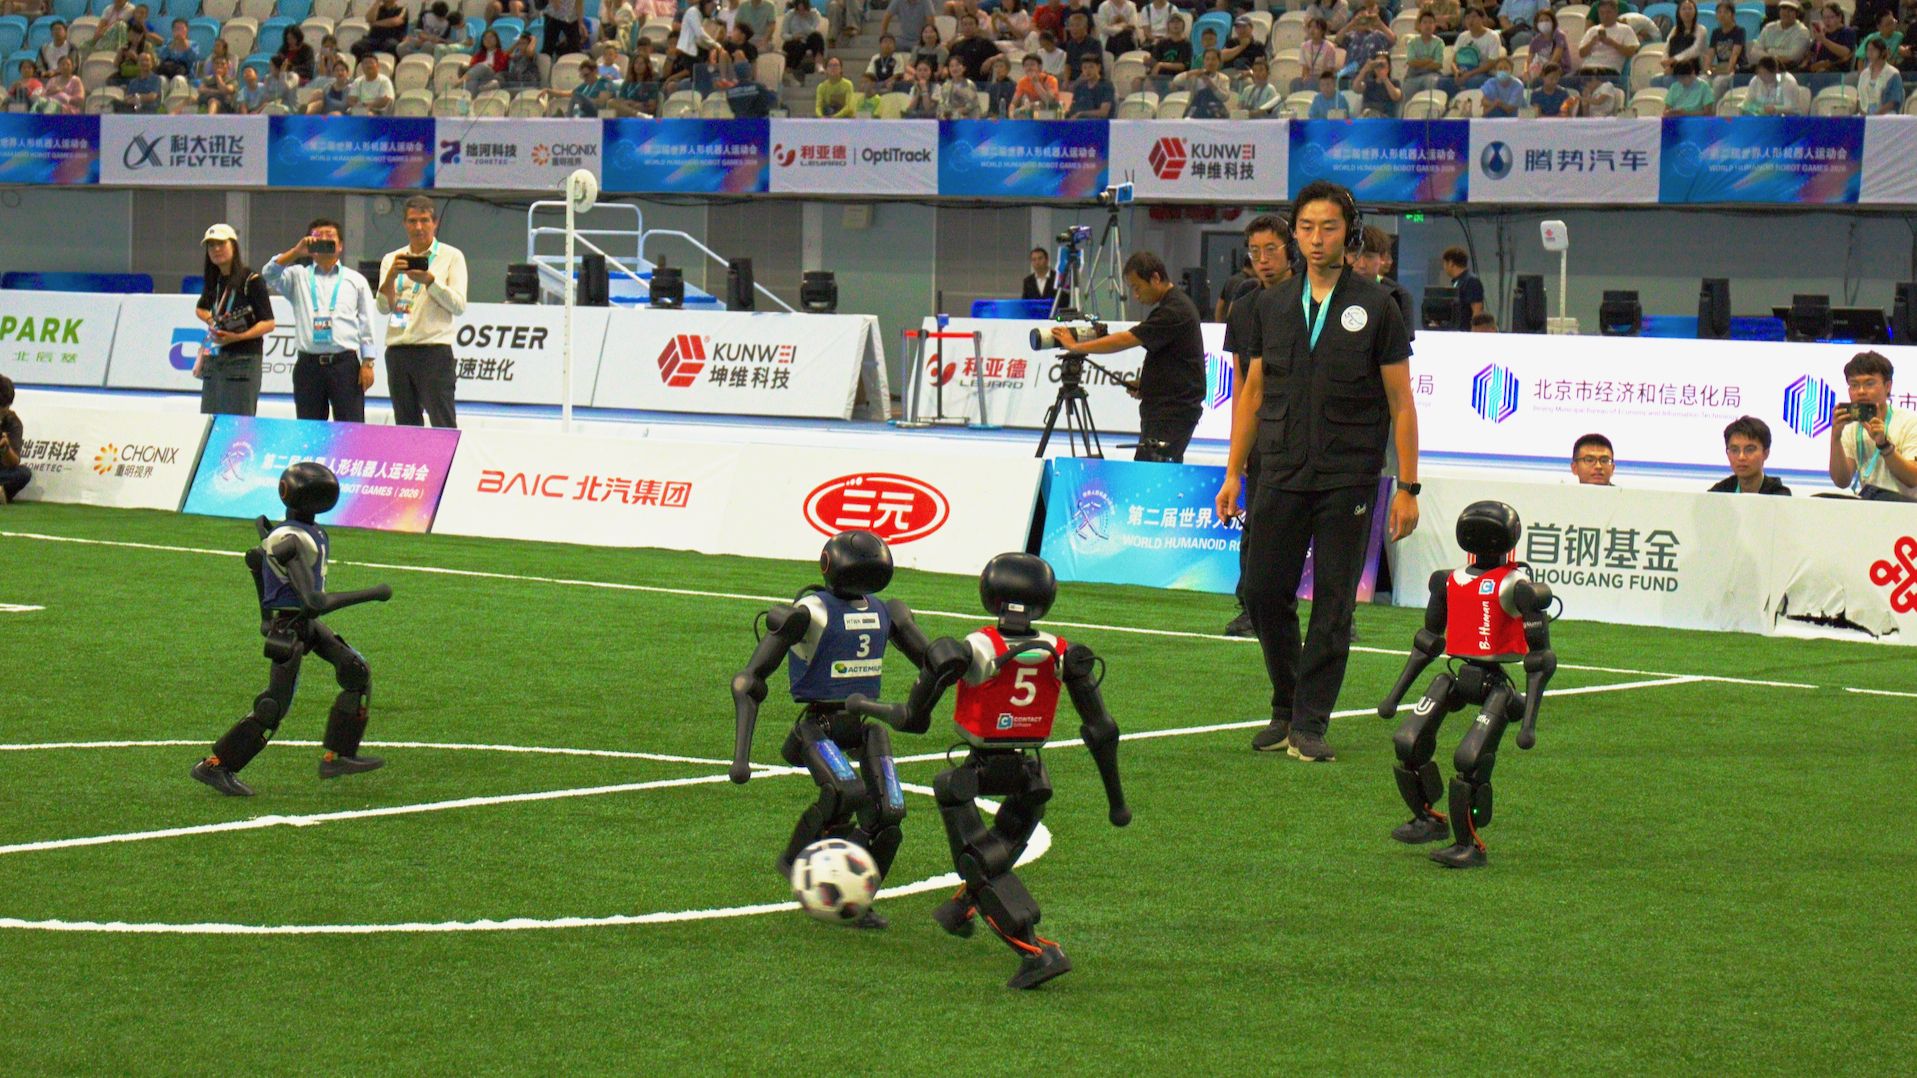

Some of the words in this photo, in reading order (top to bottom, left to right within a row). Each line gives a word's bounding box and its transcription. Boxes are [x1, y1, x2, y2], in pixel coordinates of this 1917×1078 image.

[170, 135, 244, 154] 科大讯飞
[552, 144, 597, 156] CHONIX
[800, 145, 846, 160] 利亚德
[1192, 144, 1255, 159] KUNWEI
[861, 148, 931, 165] OptiTrack
[1525, 149, 1648, 172] 腾势汽车
[1191, 161, 1254, 180] 坤维科技
[0, 316, 83, 344] PARK
[265, 324, 295, 357] 元
[457, 324, 548, 350] OSTER
[713, 343, 797, 364] KUNWEI
[455, 358, 515, 381] 速进化
[708, 365, 790, 389] 坤维科技
[962, 357, 1027, 379] 利亚德
[1048, 361, 1141, 386] OtiTrac
[1534, 379, 1741, 408] 北京市经济和信息化局
[121, 444, 179, 464] CHONIX
[114, 463, 153, 478] 重明视界
[261, 452, 429, 481] 第二人形机器人运动会
[361, 485, 393, 496] GAMES
[477, 470, 569, 498] BAIC
[572, 475, 692, 508] 北汽集团
[835, 489, 915, 530] 三元
[1127, 504, 1246, 530] 第二届世界人形
[1123, 533, 1162, 549] WORLD
[1165, 537, 1226, 551] HUMANOID
[1526, 522, 1680, 572] 首钢基金
[1630, 575, 1678, 592] FUND
[1479, 601, 1491, 650] B-Human
[856, 633, 871, 658] 3
[1009, 667, 1038, 707] 5
